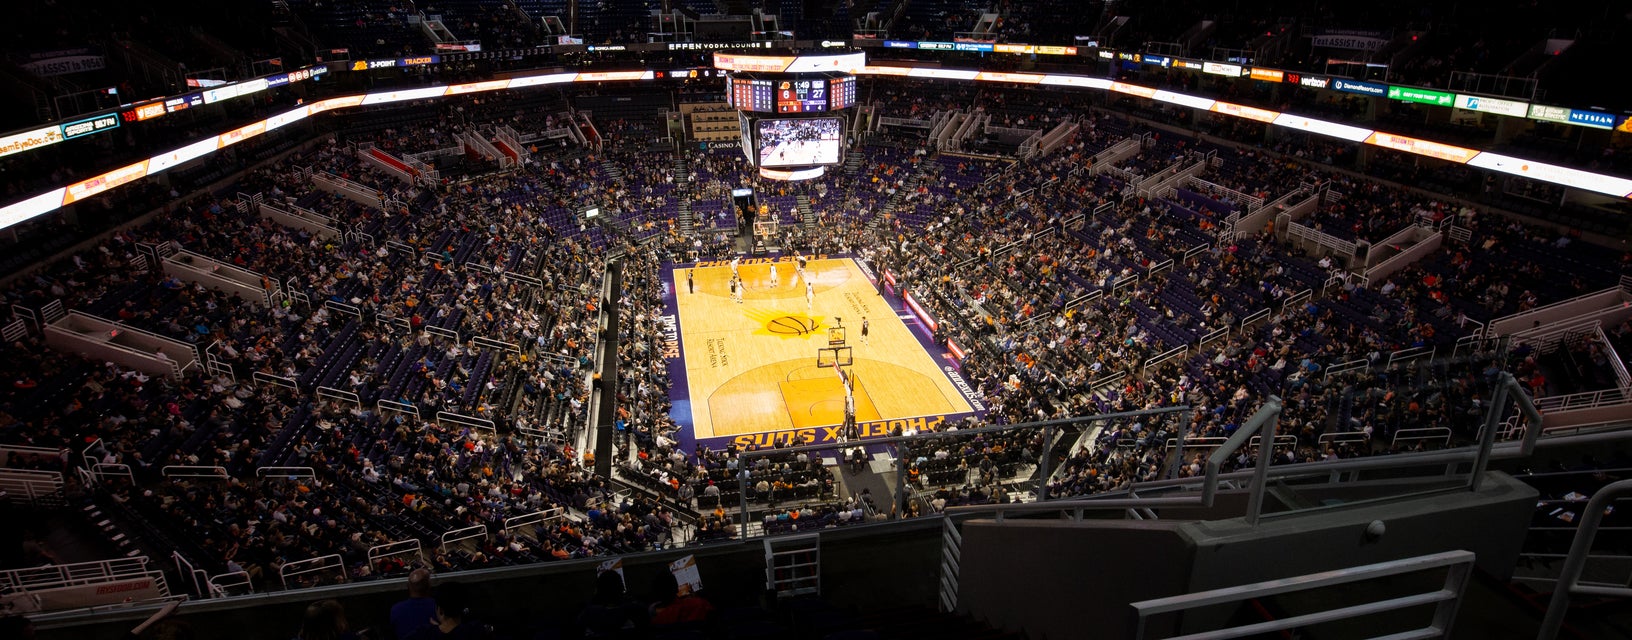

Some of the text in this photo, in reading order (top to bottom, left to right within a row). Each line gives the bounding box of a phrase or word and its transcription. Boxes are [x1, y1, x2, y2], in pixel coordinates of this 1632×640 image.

[1329, 38, 1356, 48] ASSIST
[41, 60, 71, 74] ASSIST
[370, 57, 432, 68] 3-POINT TRACKER
[795, 81, 809, 89] 1:49
[1301, 78, 1325, 89] verizon
[1343, 83, 1384, 94] DiamondResorts.com
[783, 90, 789, 99] 6
[812, 90, 823, 99] 27
